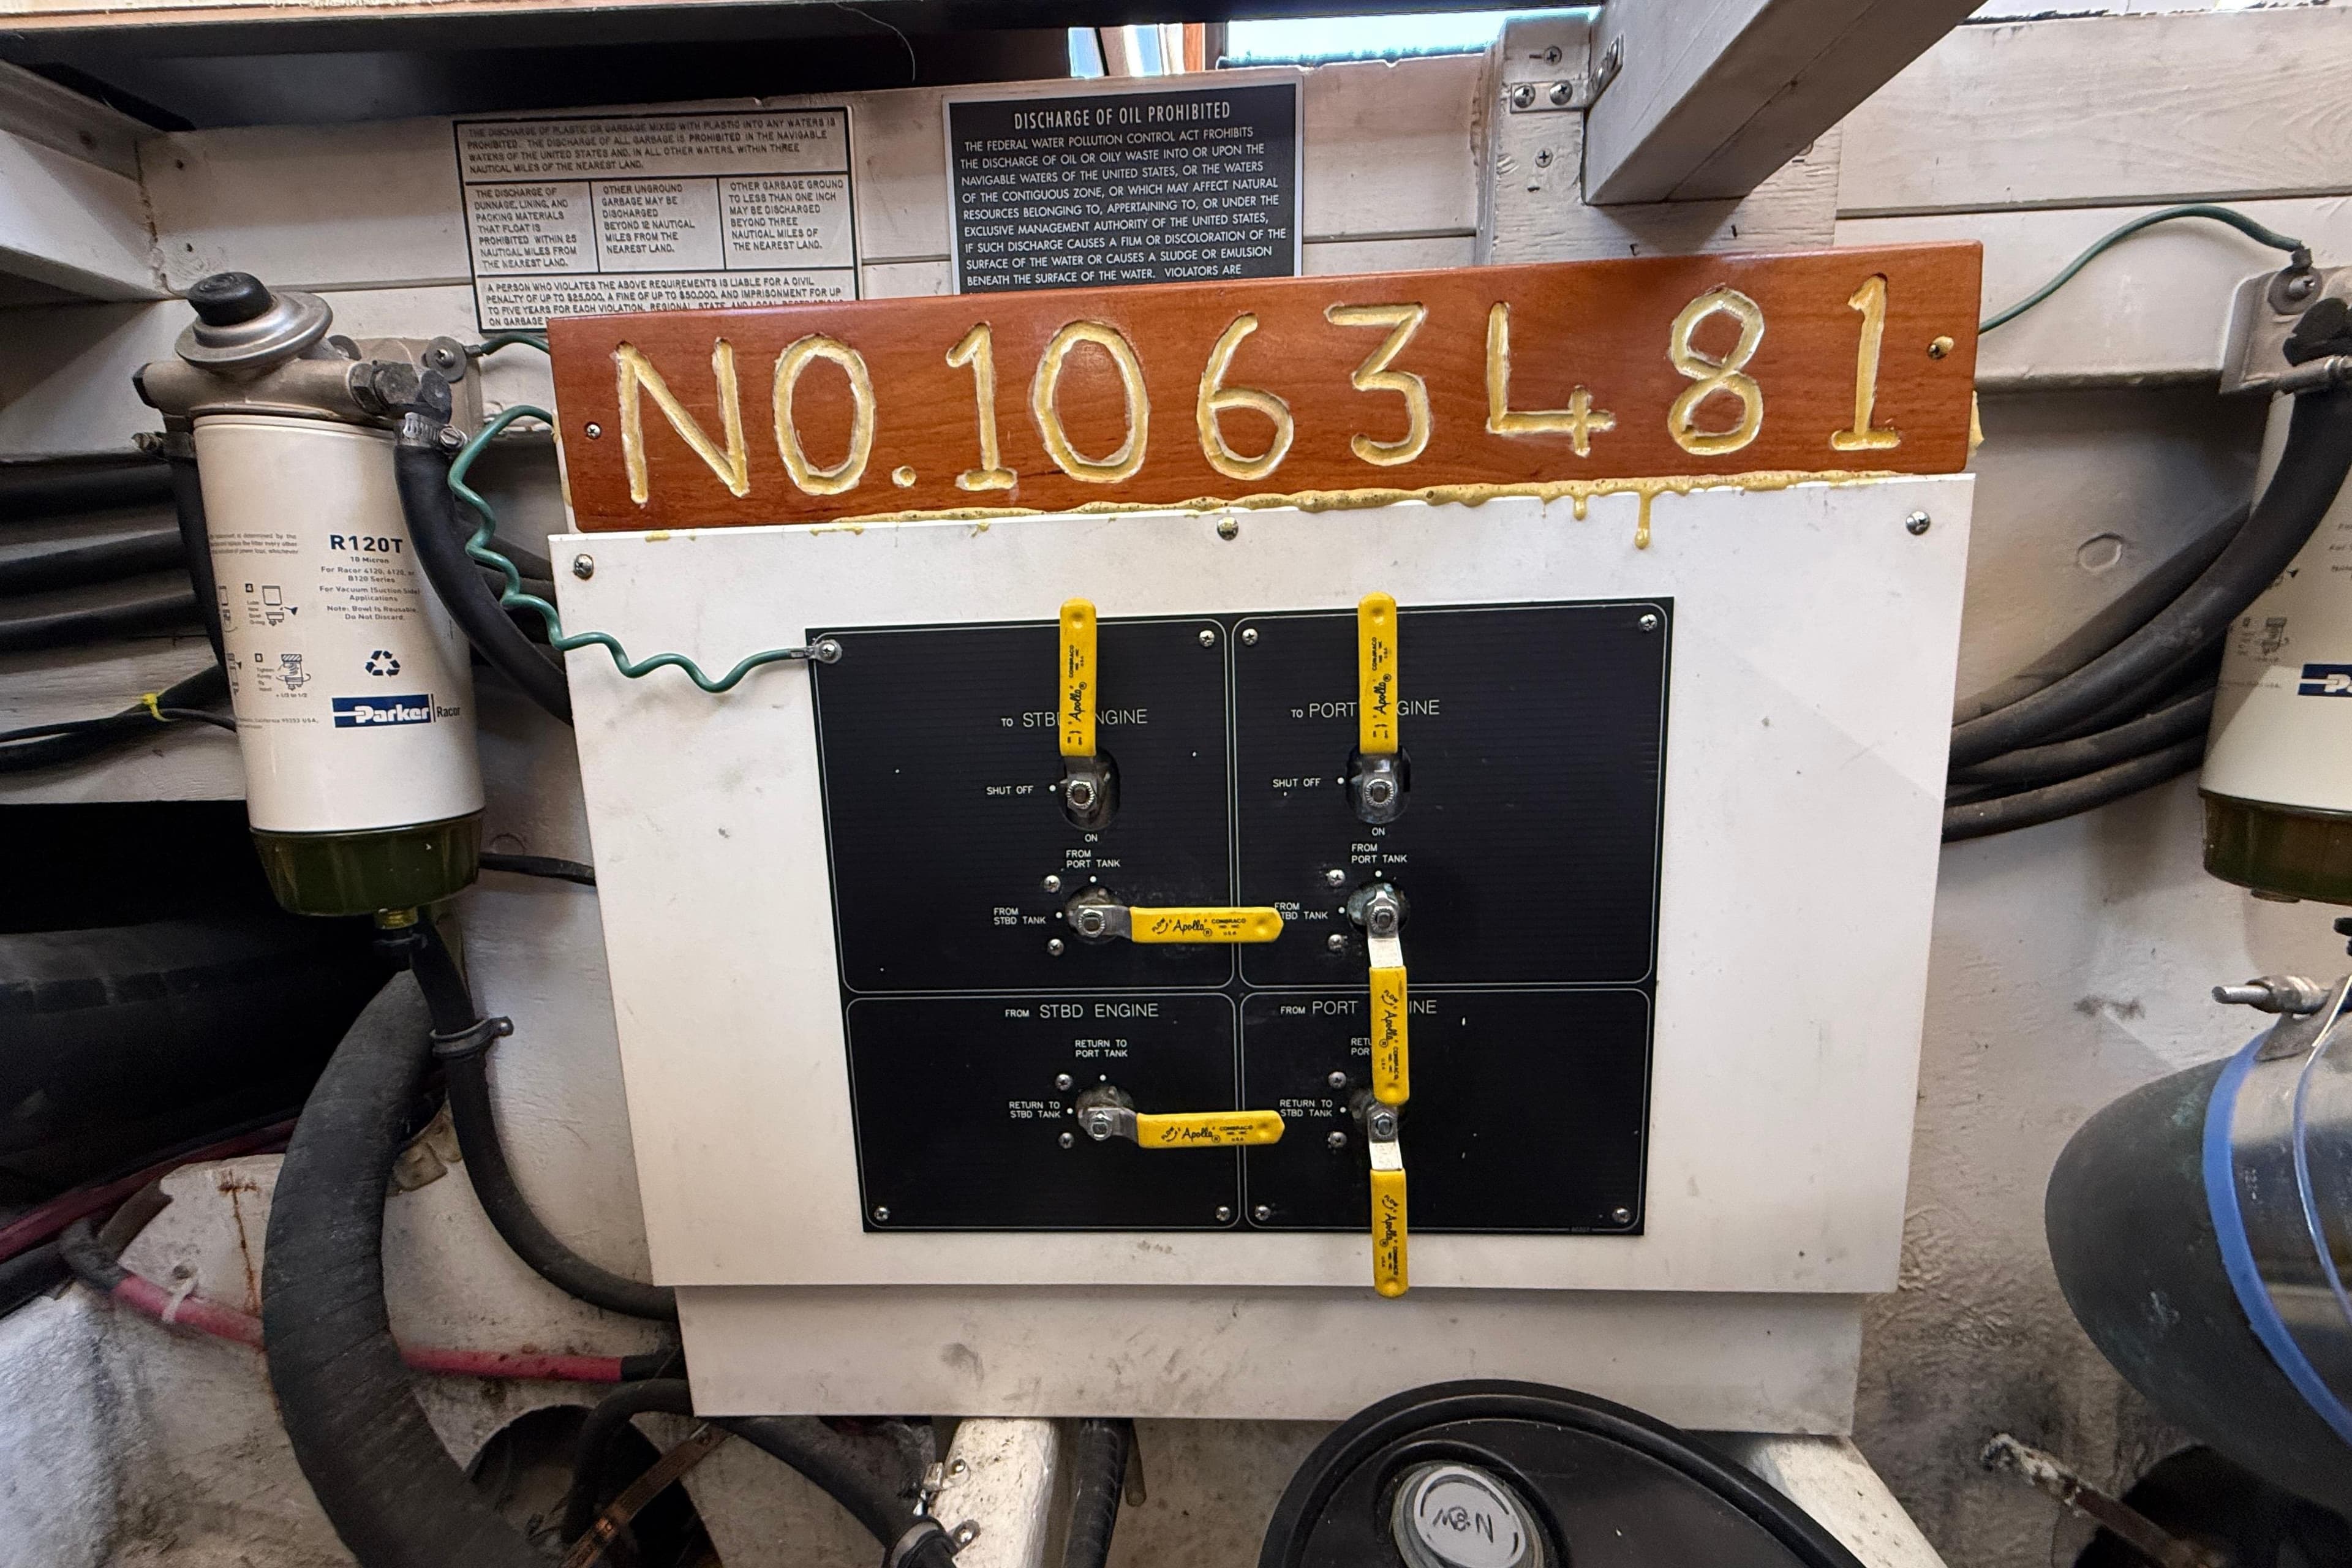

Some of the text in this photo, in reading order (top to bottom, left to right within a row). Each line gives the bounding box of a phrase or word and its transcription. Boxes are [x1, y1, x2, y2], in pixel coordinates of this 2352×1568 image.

[1015, 102, 1229, 129] DISCHARGE OF OIL PROHIBITED
[965, 141, 982, 152] THE
[987, 139, 1028, 151] FEDERAL
[1031, 137, 1064, 148] WATER
[1069, 135, 1122, 146] POLLUTION
[1127, 131, 1175, 144] CONTROL
[1179, 129, 1199, 141] ACT
[960, 143, 1264, 169] THE DISCHARGE OF OIL OR OILY WASTE INTO OR UPON THE
[962, 160, 1263, 186] NAVIGABLE WATERS OF THE UNITED STATES, OR THE WATERS
[730, 179, 843, 191] OTHER GARBAGE GROUND
[962, 178, 1278, 203] OF THE CONTIGUOUS ZONE, OR WHICH MAY AFFECT NATURAL
[728, 192, 836, 203] TO LESS THAN ONE INCH
[729, 204, 820, 216] MAY BE DISCHARGED
[963, 194, 1279, 220] RESOURCES BELONGING TO, APPERTAINING TO, OR UNDER THE
[731, 217, 798, 228] BEYOND THREE
[732, 228, 818, 239] NAUTICAL MILES OF
[733, 242, 751, 251] THE
[753, 241, 794, 251] NEAREST
[330, 534, 403, 554] R120T
[354, 704, 461, 723] Parker Racor
[1291, 699, 1440, 718] TO PORT GINE
[1001, 708, 1148, 728] TO STB NGINE
[1272, 778, 1321, 788] SHUT OFF
[986, 785, 1034, 796] SHUT OFF
[1371, 827, 1385, 837] ON
[1084, 833, 1098, 843] ON
[1066, 849, 1091, 858] FROM
[1351, 843, 1378, 853] FROM
[1066, 859, 1121, 869] PORT TANK
[1351, 853, 1408, 864] PORT TANK
[993, 907, 1019, 916] FROM
[1274, 902, 1300, 911] FROM
[993, 914, 1046, 925] STBD TANK
[1280, 911, 1329, 920] TBD TANK
[1005, 1003, 1159, 1019] FROM STBD ENGINE
[1280, 1006, 1306, 1015] FROM
[1312, 1000, 1359, 1016] PORT
[1075, 1039, 1128, 1048] RETURN TO
[1075, 1049, 1128, 1058] PORT TANK
[1351, 1047, 1370, 1057] POR
[1009, 1101, 1061, 1110] RETURN TO
[1280, 1099, 1333, 1108] RETURN TO
[1280, 1109, 1333, 1118] STBD TANK
